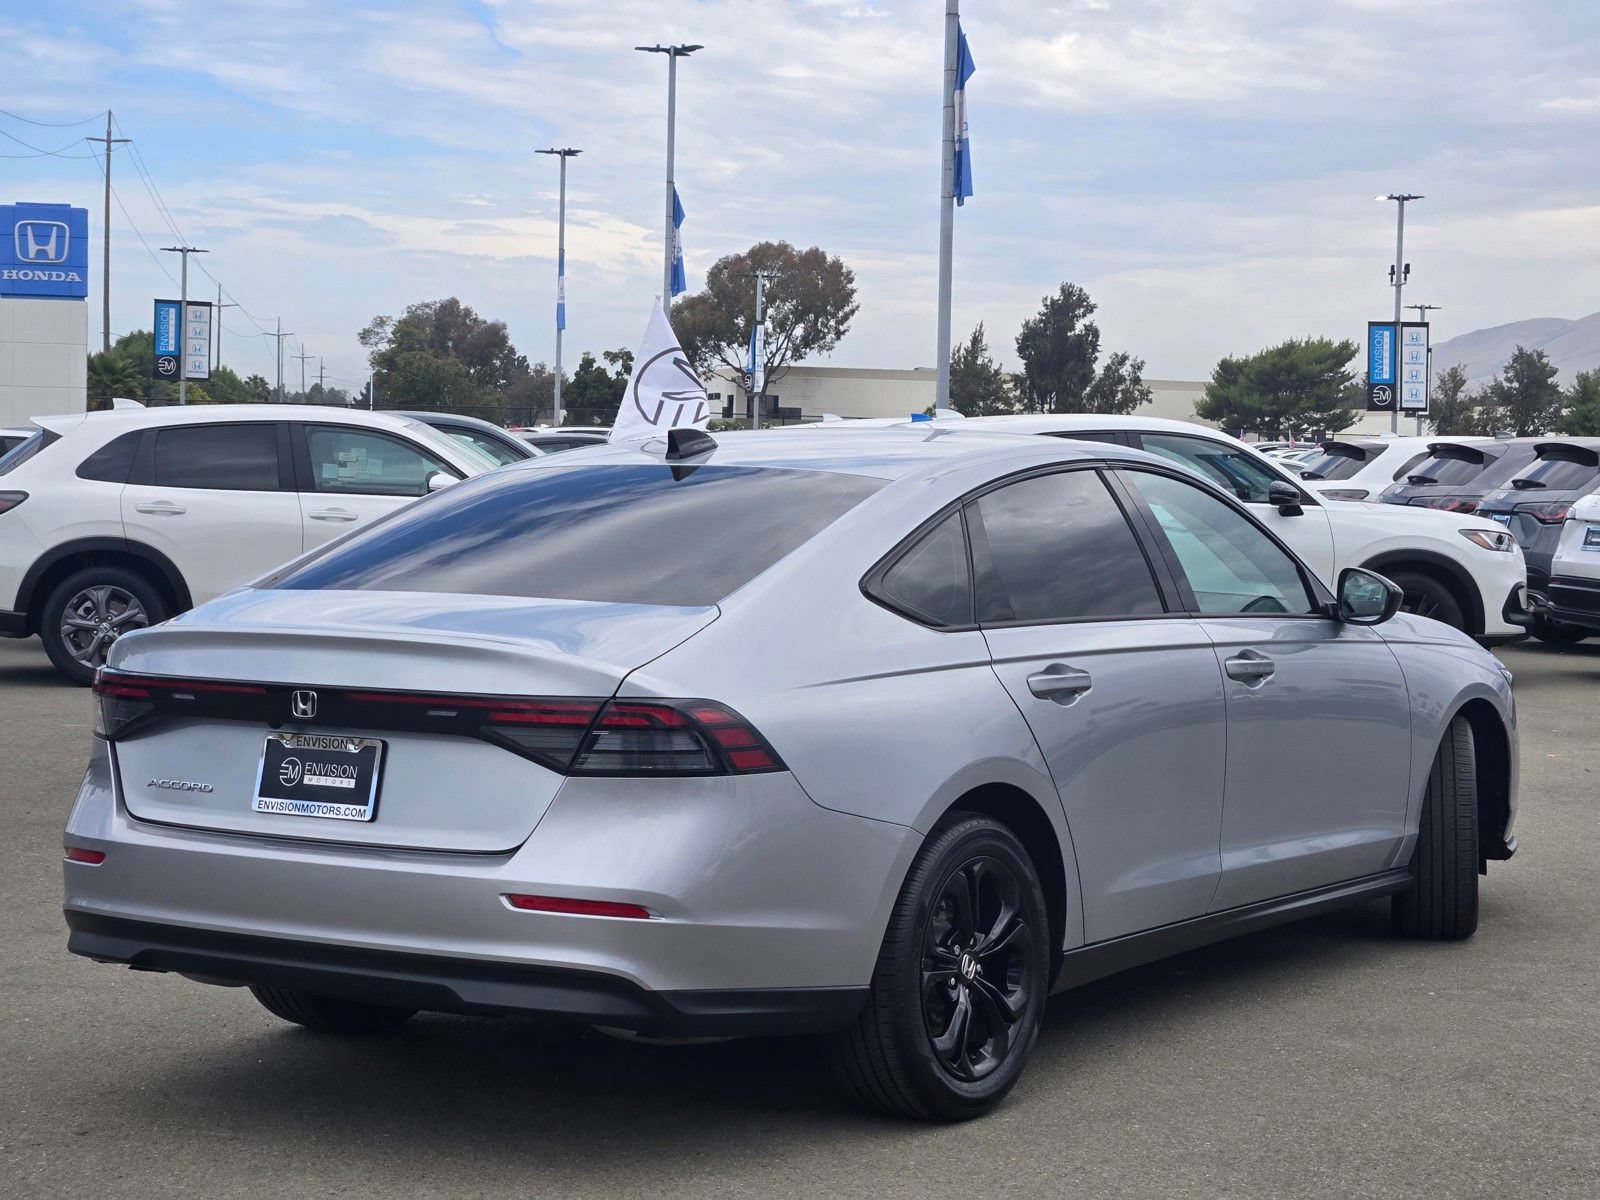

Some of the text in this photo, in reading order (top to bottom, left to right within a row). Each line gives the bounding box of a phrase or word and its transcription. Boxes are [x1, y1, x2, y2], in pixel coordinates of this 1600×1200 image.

[1, 269, 82, 282] HONDA
[160, 307, 169, 351] ENVISION
[1374, 330, 1383, 379] ENVISION
[296, 736, 348, 750] ENVISION
[304, 762, 358, 778] ENVISION
[147, 778, 214, 793] ACCORD
[308, 777, 351, 786] MOTORS
[257, 800, 366, 818] ENVISIONMOTORS.COM
